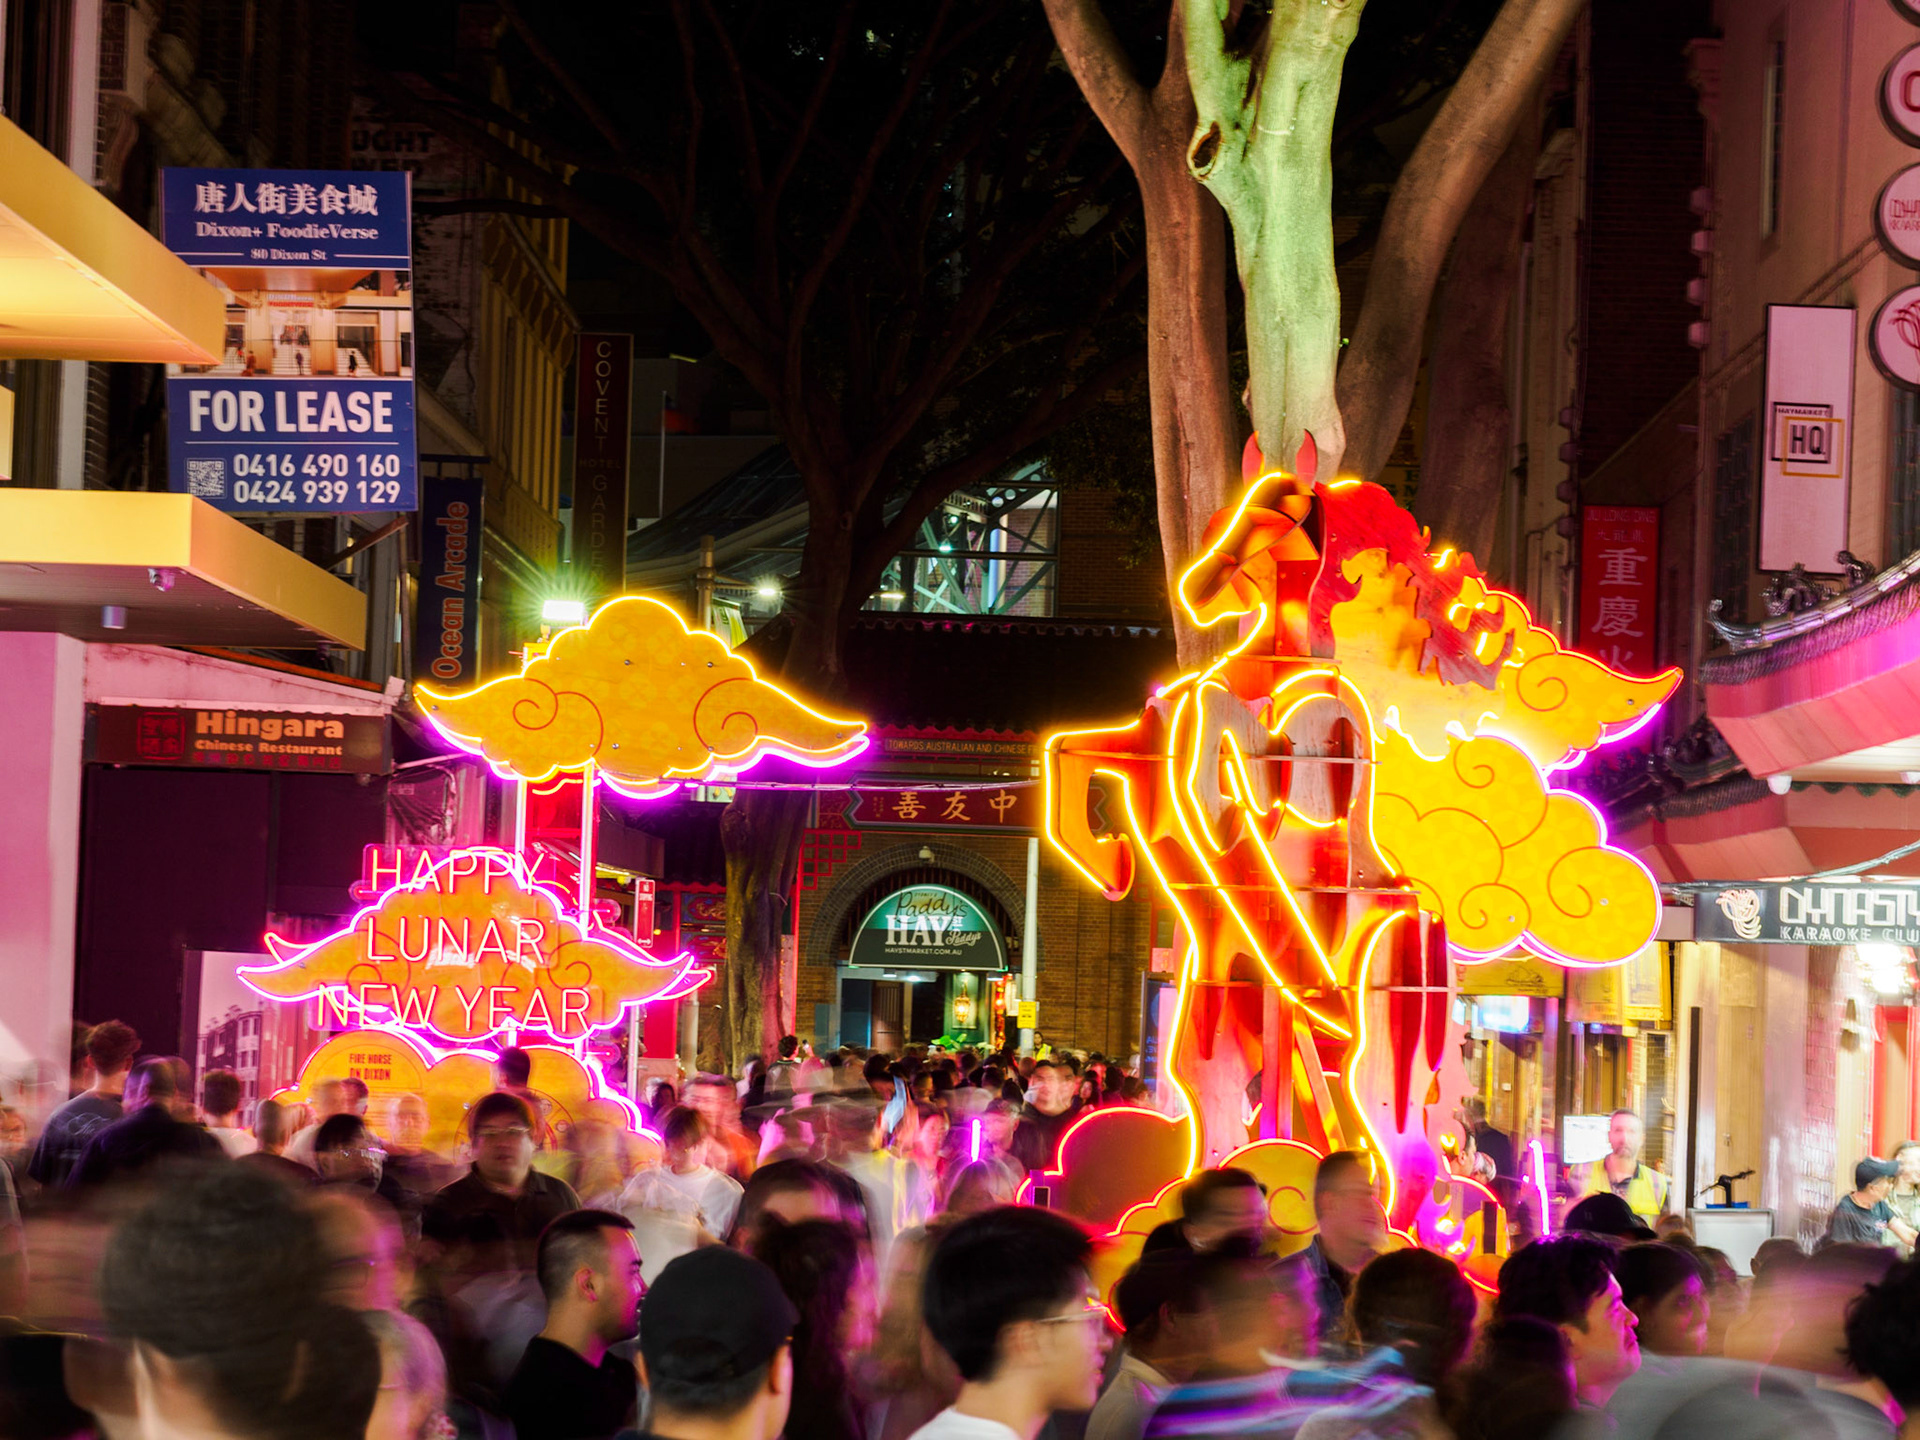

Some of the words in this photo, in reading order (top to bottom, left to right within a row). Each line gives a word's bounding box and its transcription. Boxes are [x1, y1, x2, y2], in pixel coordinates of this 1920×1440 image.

[194, 181, 379, 216] 唐人街美食城
[196, 222, 263, 238] Dixon+
[266, 223, 379, 239] FoodieVerse
[270, 249, 310, 261] Dixon
[311, 249, 328, 261] St
[595, 340, 612, 452] COVENT
[189, 390, 265, 432] FOR
[275, 391, 394, 433] LEASE
[1790, 424, 1826, 455] HQ
[233, 454, 295, 476] 0416
[301, 454, 348, 476] 490
[356, 454, 400, 477] 160
[579, 458, 622, 469] HOTEL
[233, 481, 296, 503] 0424
[302, 481, 348, 503] 939
[356, 481, 400, 503] 129
[435, 501, 470, 592] Arcade
[431, 597, 465, 679] Ocean
[195, 711, 344, 741] Hingara
[195, 740, 253, 752] Chinese
[258, 743, 342, 756] Restaurant
[889, 738, 924, 750] TOWARDS
[926, 740, 974, 752] AUSTRALIAN
[976, 743, 992, 752] AND
[994, 743, 1026, 754] CHINESE
[372, 849, 544, 894] HAPPY
[368, 917, 544, 964] LUNAR
[885, 915, 949, 946] HAY
[1780, 926, 1872, 941] KARAOKE
[885, 947, 962, 955] HAYSTMARKET.COM.AU
[318, 984, 437, 1029] NEW
[455, 985, 595, 1032] YEAR
[349, 1053, 365, 1064] FIRE
[368, 1054, 392, 1065] HORSE
[350, 1068, 361, 1079] ON
[364, 1068, 391, 1080] DIXON
